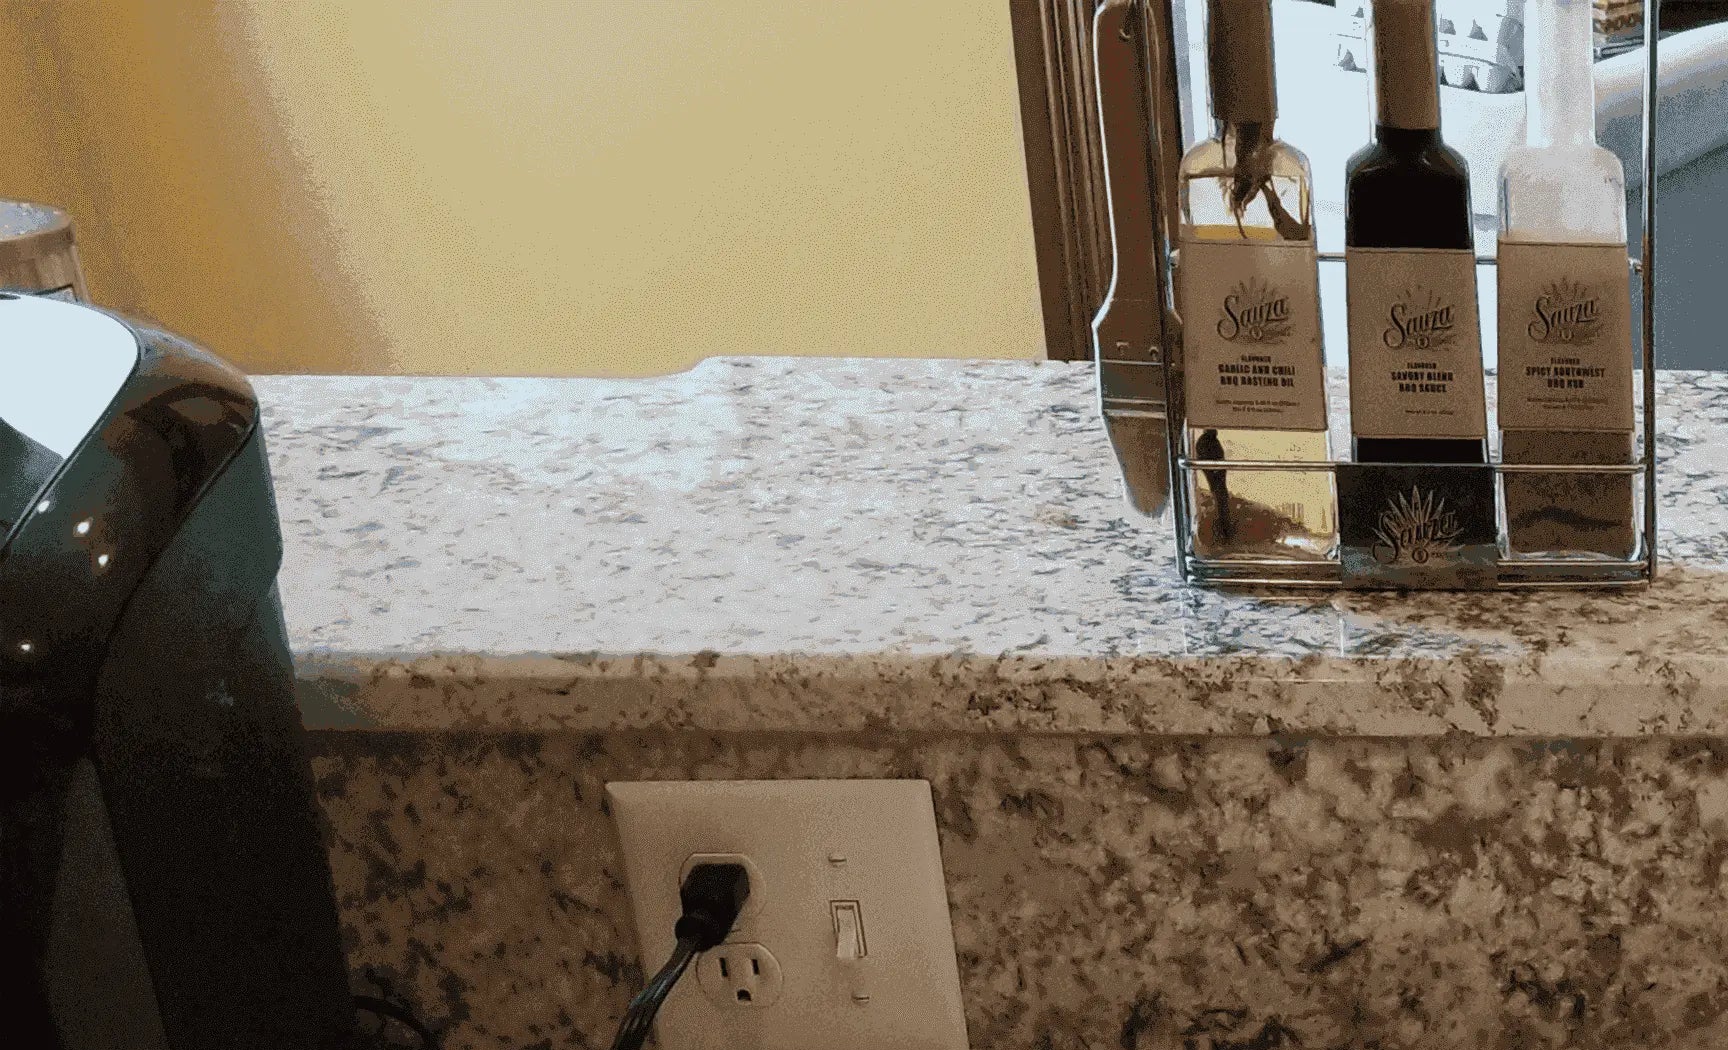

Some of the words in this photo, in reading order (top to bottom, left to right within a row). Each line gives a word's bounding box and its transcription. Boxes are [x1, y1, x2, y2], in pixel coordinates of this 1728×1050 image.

[1217, 295, 1289, 341] Sauza
[1528, 296, 1600, 342] Sauza
[1383, 303, 1455, 350] Sauza
[1218, 364, 1250, 374] GARLIC
[1252, 365, 1270, 375] AND
[1526, 366, 1551, 377] SPICY
[1553, 367, 1605, 378] SOUTHWEST
[1220, 376, 1239, 387] BBQ
[1241, 376, 1279, 387] BASTING
[1281, 377, 1295, 388] OIL
[1391, 372, 1425, 381] SAVORY
[1427, 372, 1453, 381] BLEND
[1399, 383, 1417, 393] BBQ
[1419, 383, 1447, 393] SAUCE
[1547, 378, 1565, 389] BBQ
[1567, 379, 1584, 389] RUB
